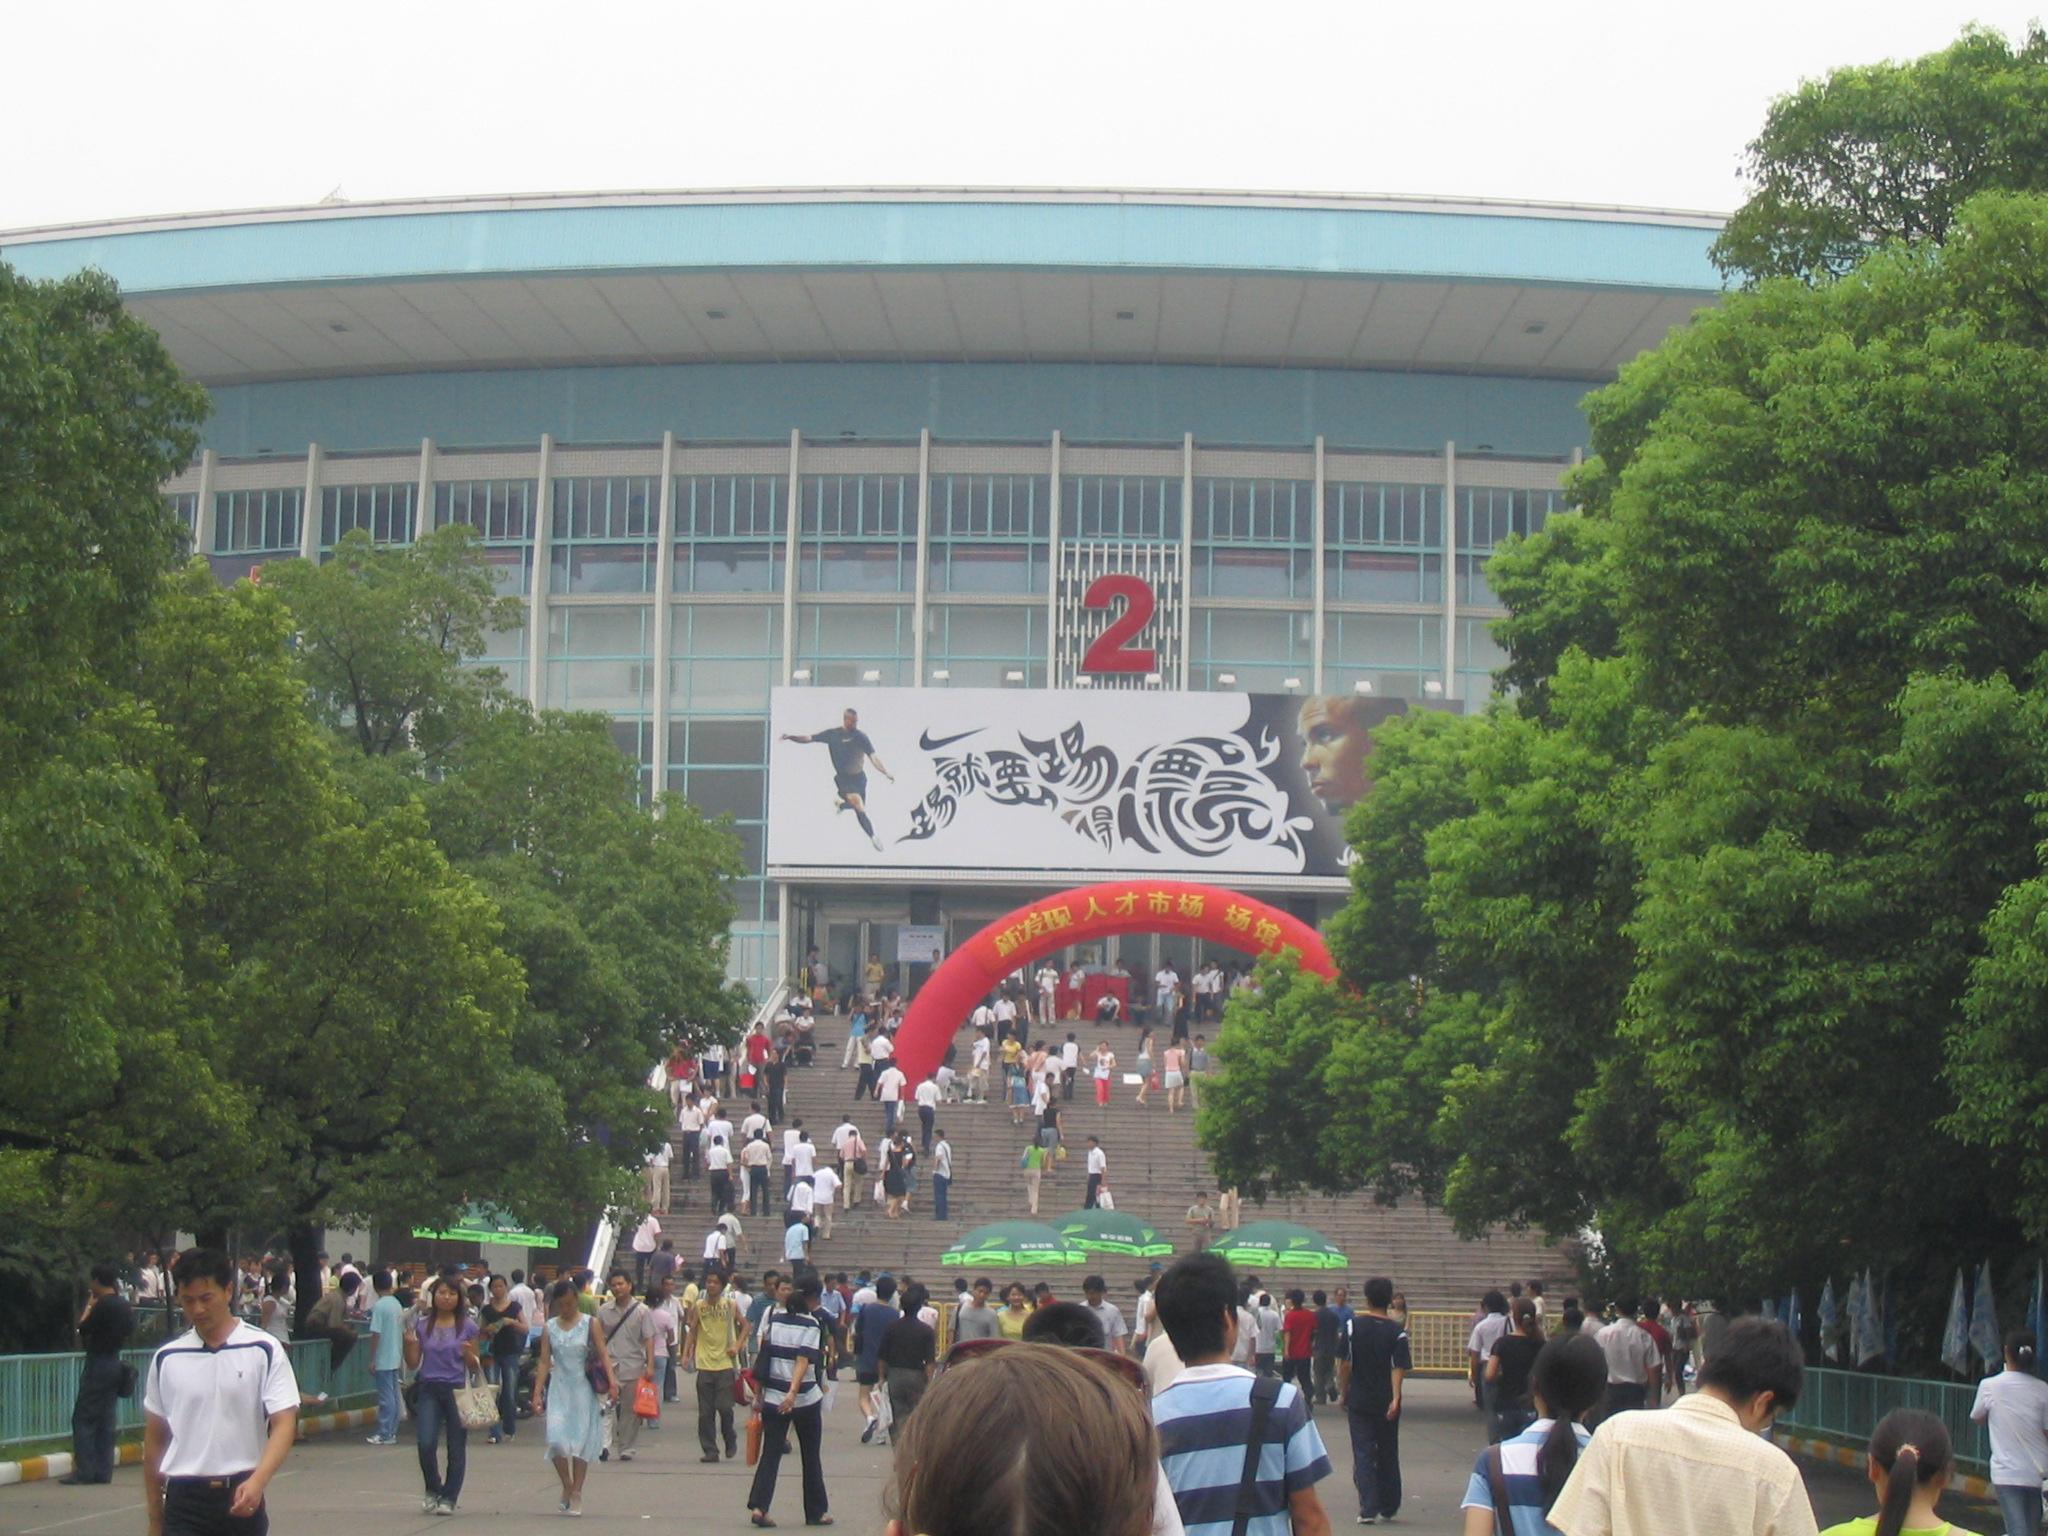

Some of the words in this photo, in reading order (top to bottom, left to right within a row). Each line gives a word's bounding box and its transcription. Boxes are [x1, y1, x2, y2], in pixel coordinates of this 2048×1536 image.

[1080, 573, 1157, 674] 2
[1084, 891, 1206, 922] 人才市场
